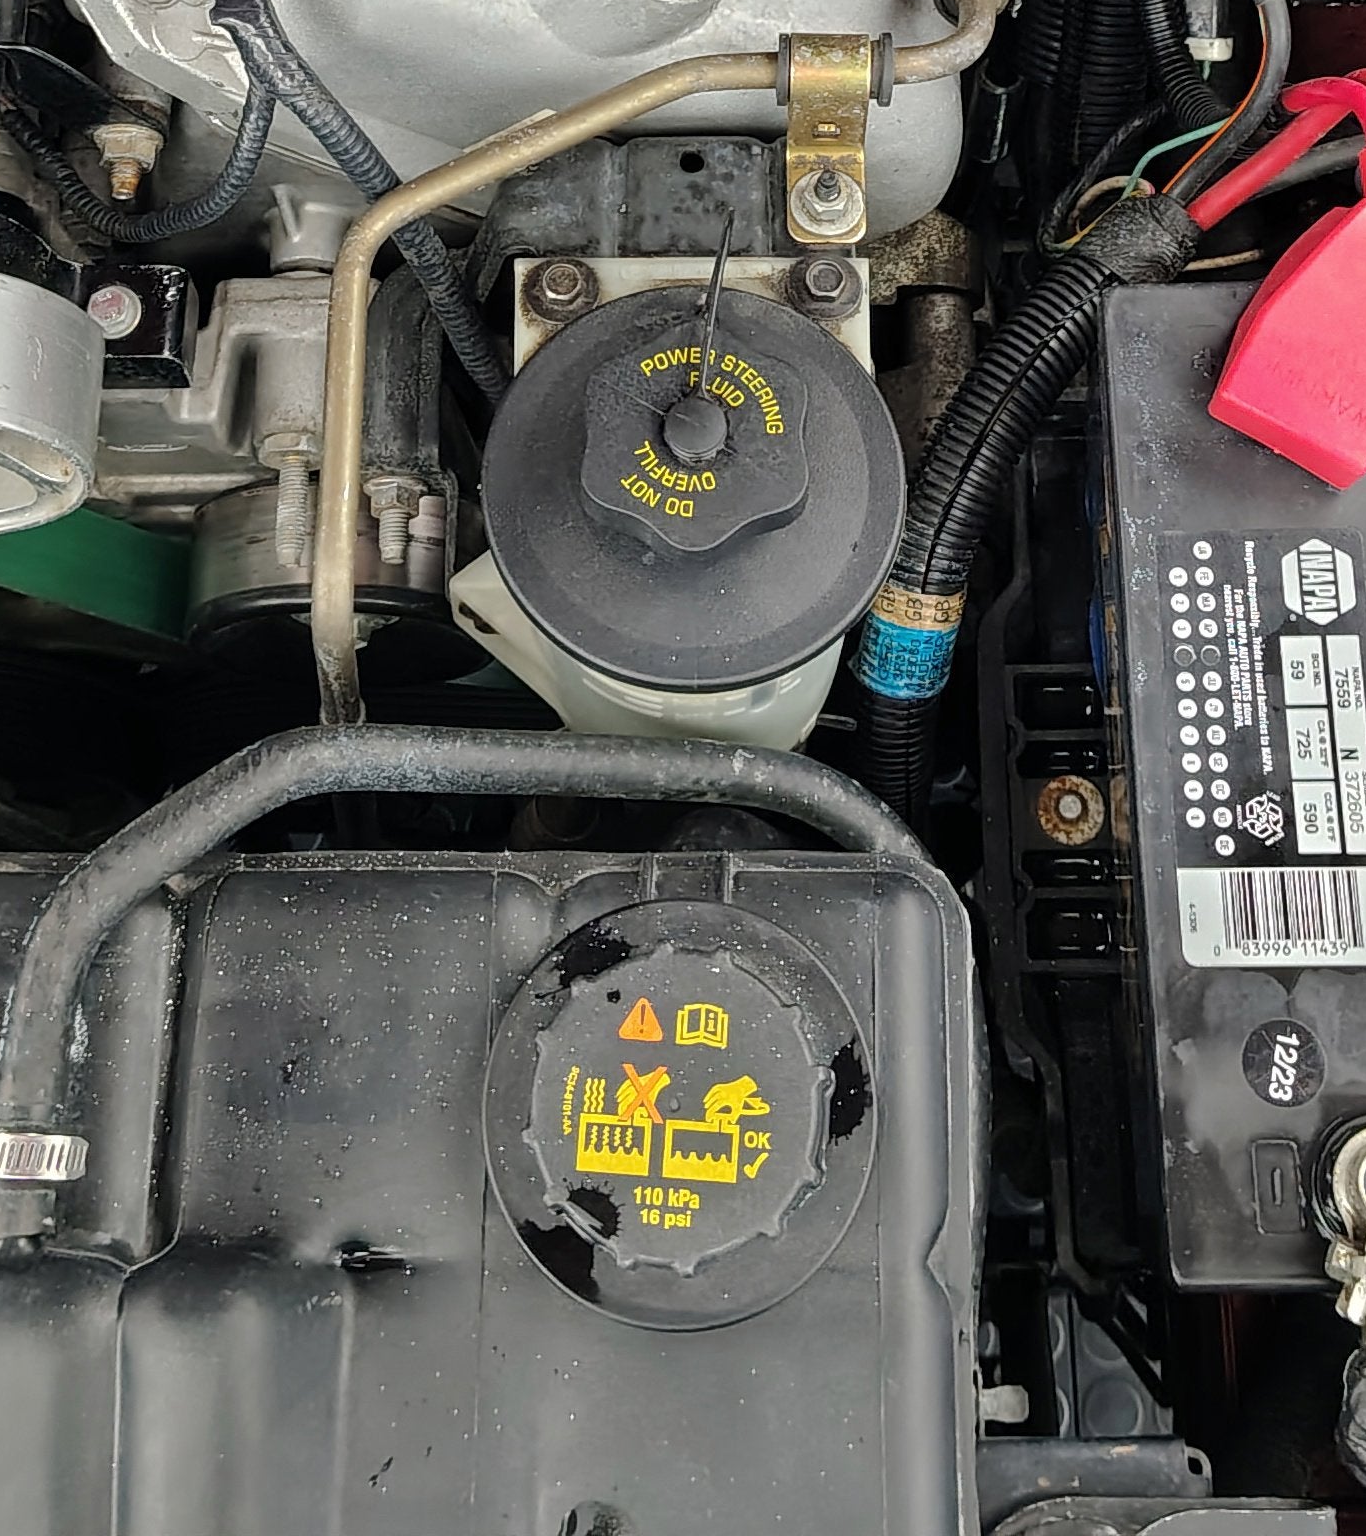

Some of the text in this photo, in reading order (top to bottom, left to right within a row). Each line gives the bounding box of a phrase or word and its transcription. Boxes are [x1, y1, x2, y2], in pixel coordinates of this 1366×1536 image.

[689, 371, 745, 407] FUID
[720, 354, 784, 435] STEERING
[634, 440, 717, 492] OVERFILL
[620, 474, 695, 518] DO NOT
[1299, 552, 1337, 613] NAPA
[905, 598, 923, 621] GB
[933, 600, 951, 624] GB
[922, 635, 934, 650] IN
[1236, 620, 1247, 645] NAPA
[1238, 646, 1249, 671] AUTO
[1291, 660, 1305, 680] 59
[1241, 672, 1252, 701] PARTS
[1296, 728, 1311, 760] 725
[1335, 668, 1364, 834] 7559 N 372605
[1303, 802, 1319, 834] 590
[1213, 946, 1221, 956] 0
[1242, 943, 1291, 956] 83996
[1301, 943, 1349, 956] 11439
[1268, 1033, 1300, 1102] 12/23
[743, 1130, 772, 1150] OK
[634, 1186, 701, 1210] 110 kPa
[640, 1209, 692, 1230] 16 psi
